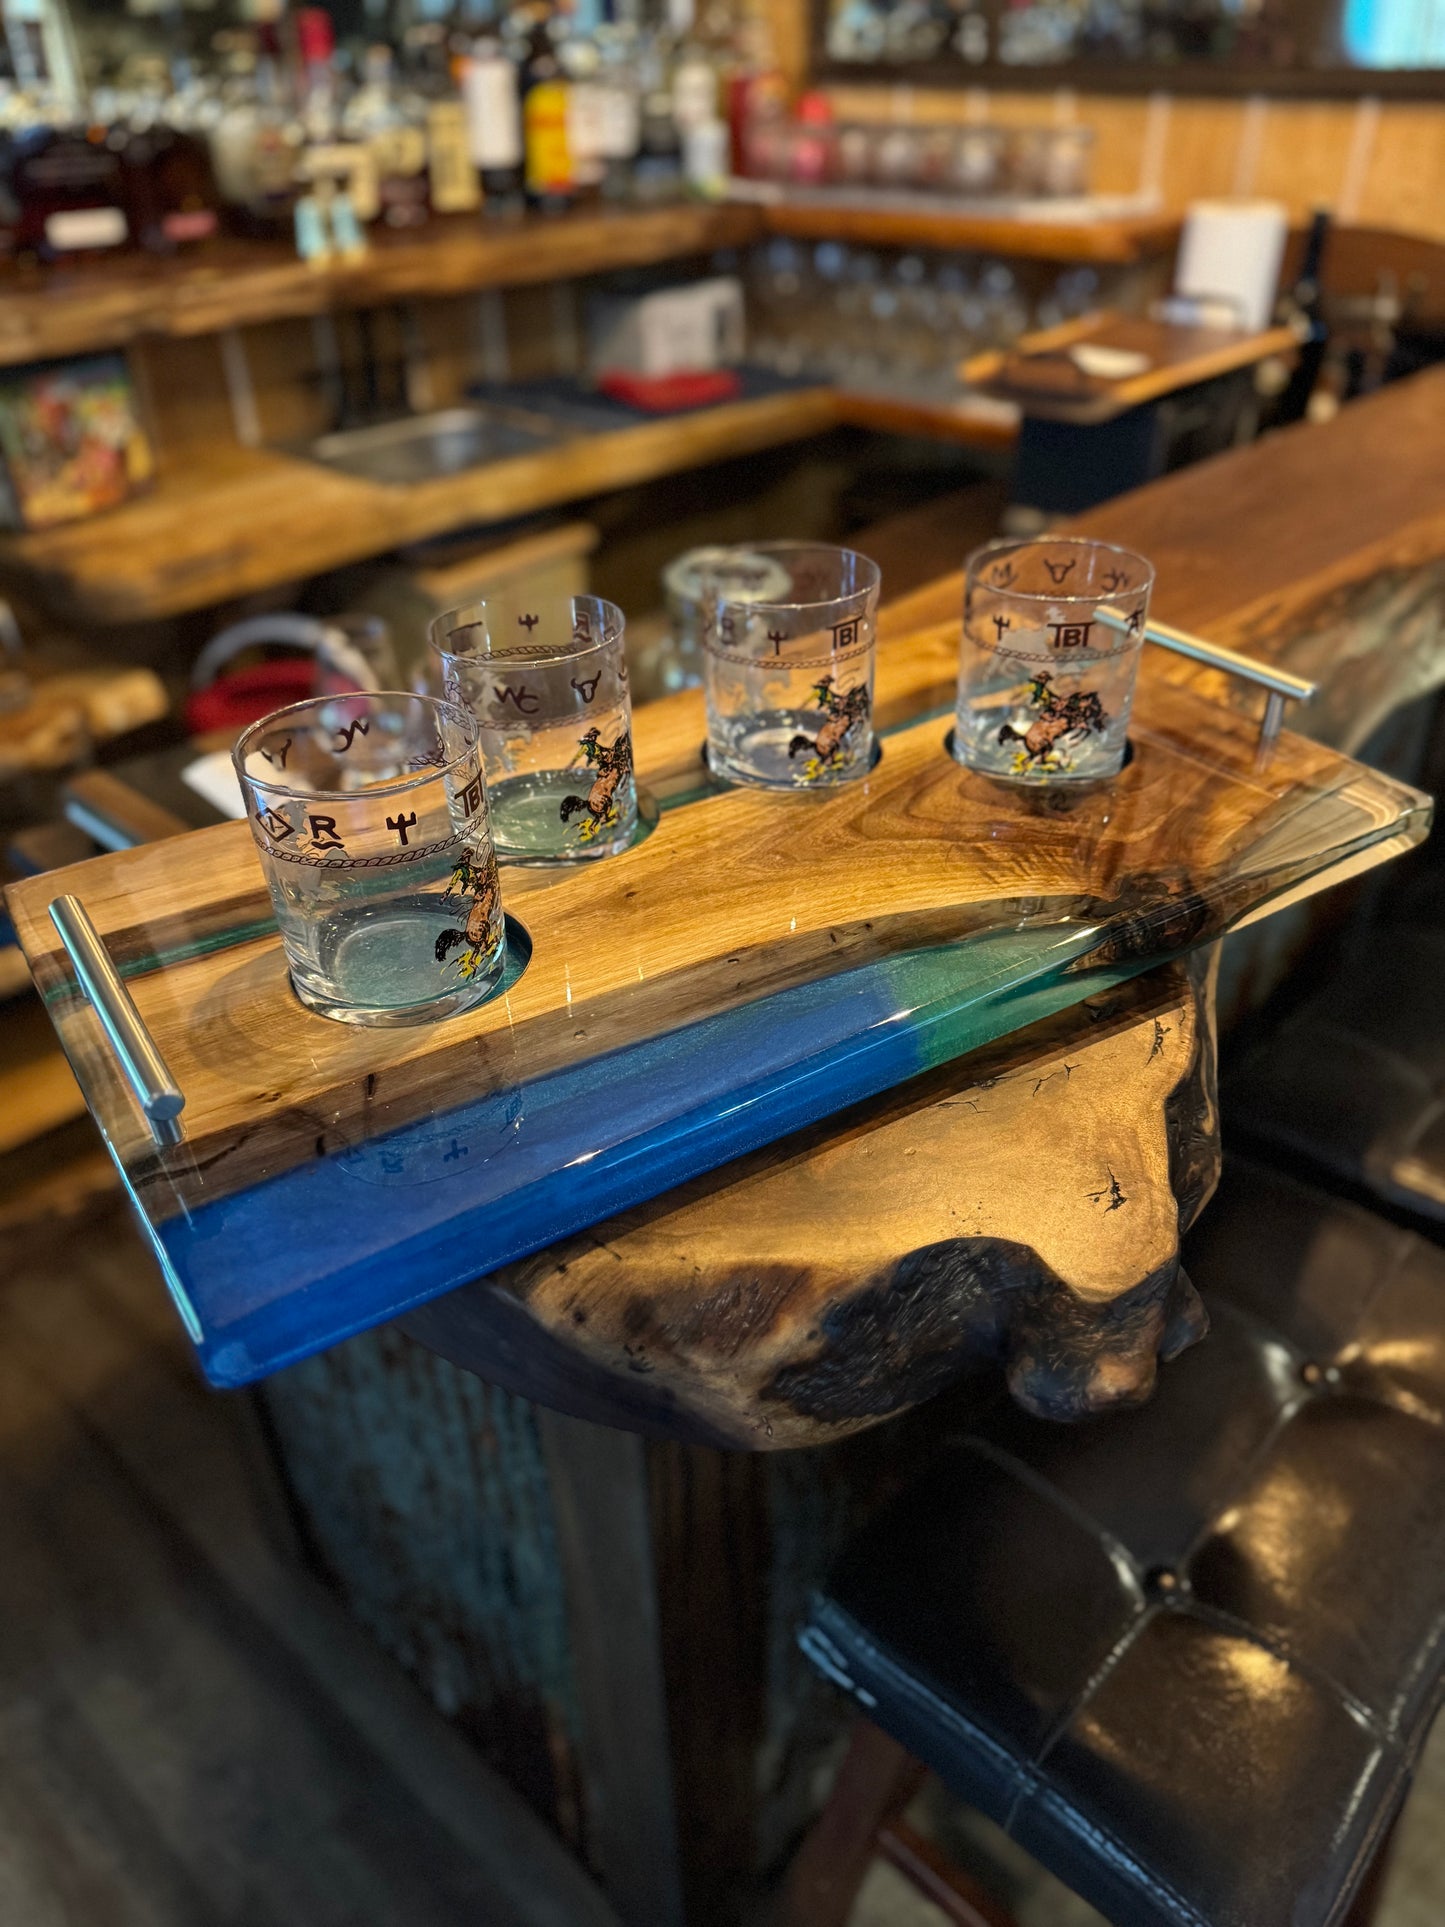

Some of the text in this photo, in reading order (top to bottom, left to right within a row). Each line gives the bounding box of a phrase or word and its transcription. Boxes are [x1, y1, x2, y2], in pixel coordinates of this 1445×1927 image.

[826, 615, 863, 650] TBT
[1047, 621, 1097, 648] TBT
[308, 768, 483, 840] R TBT
